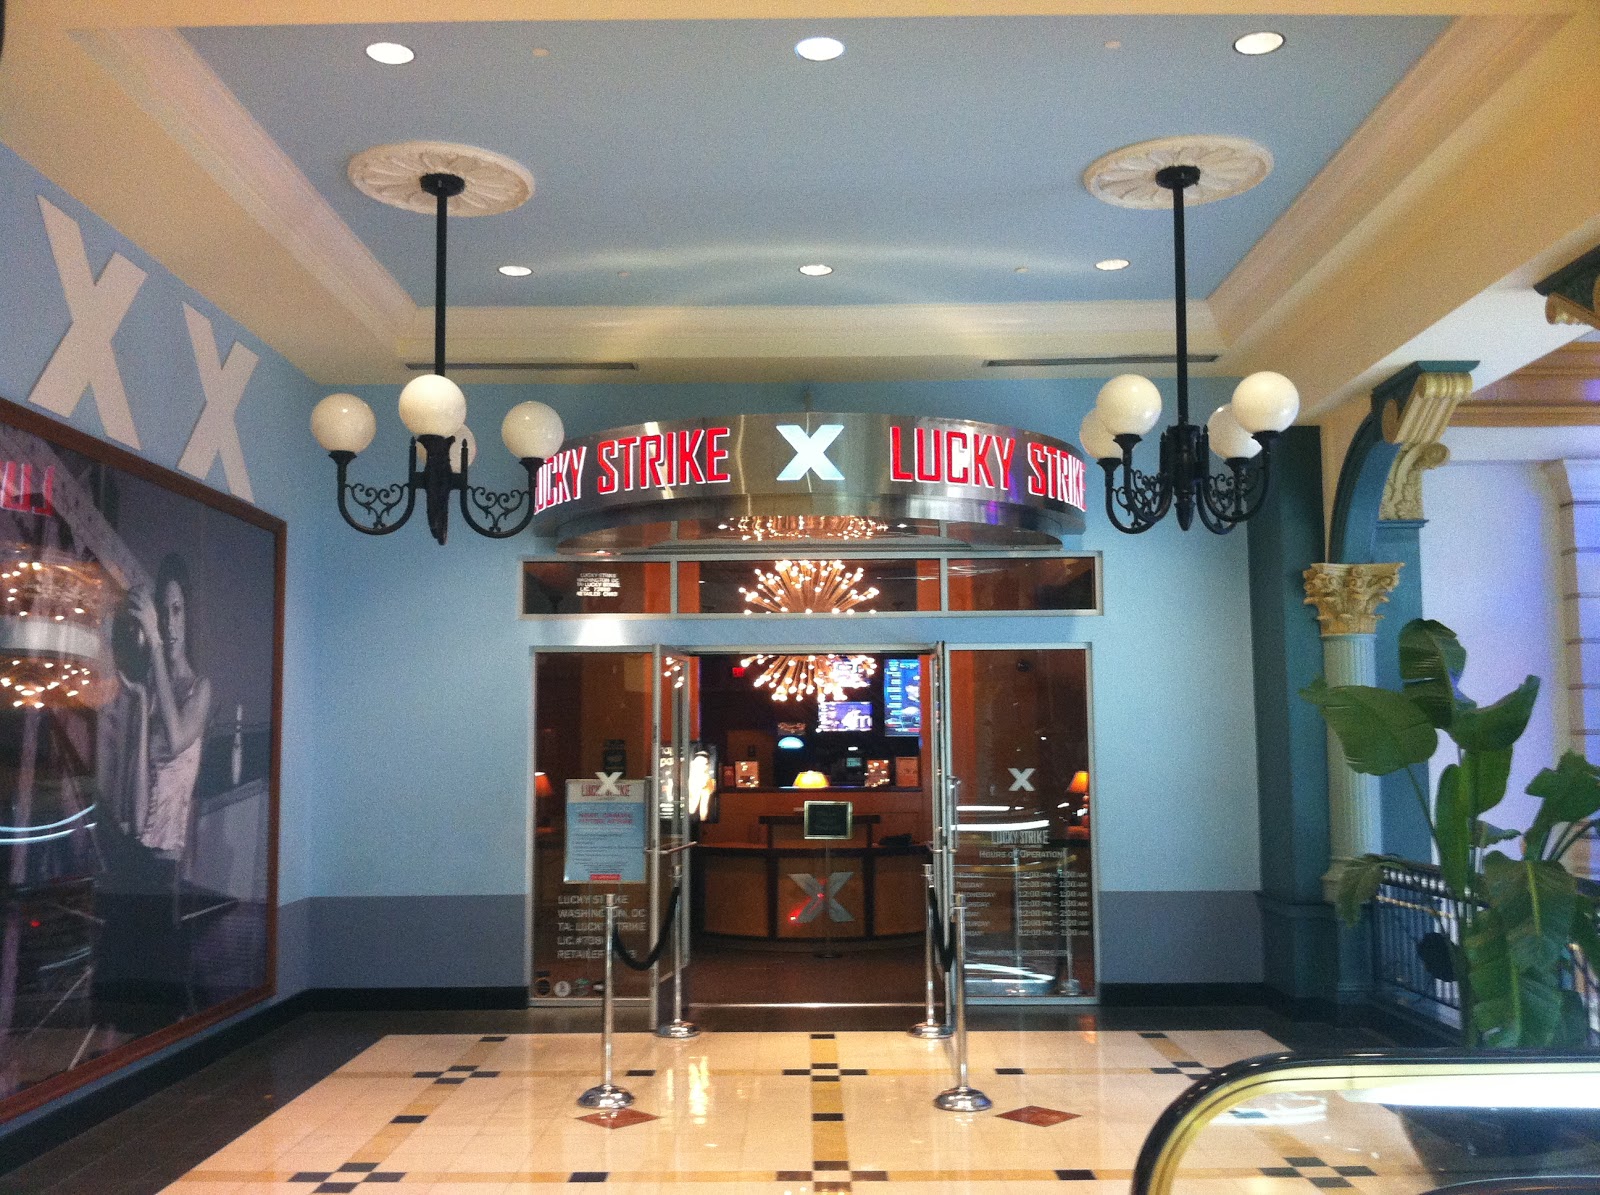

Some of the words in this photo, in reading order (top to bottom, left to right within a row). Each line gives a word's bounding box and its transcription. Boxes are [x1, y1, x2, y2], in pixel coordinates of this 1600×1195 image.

[596, 426, 731, 495] STRIKE
[776, 424, 845, 481] X
[890, 426, 1015, 490] LUCKY
[1027, 442, 1087, 512] STRIKE
[594, 771, 624, 795] X
[1007, 767, 1036, 791] X
[1019, 829, 1050, 845] STRIKE
[786, 871, 857, 923] X
